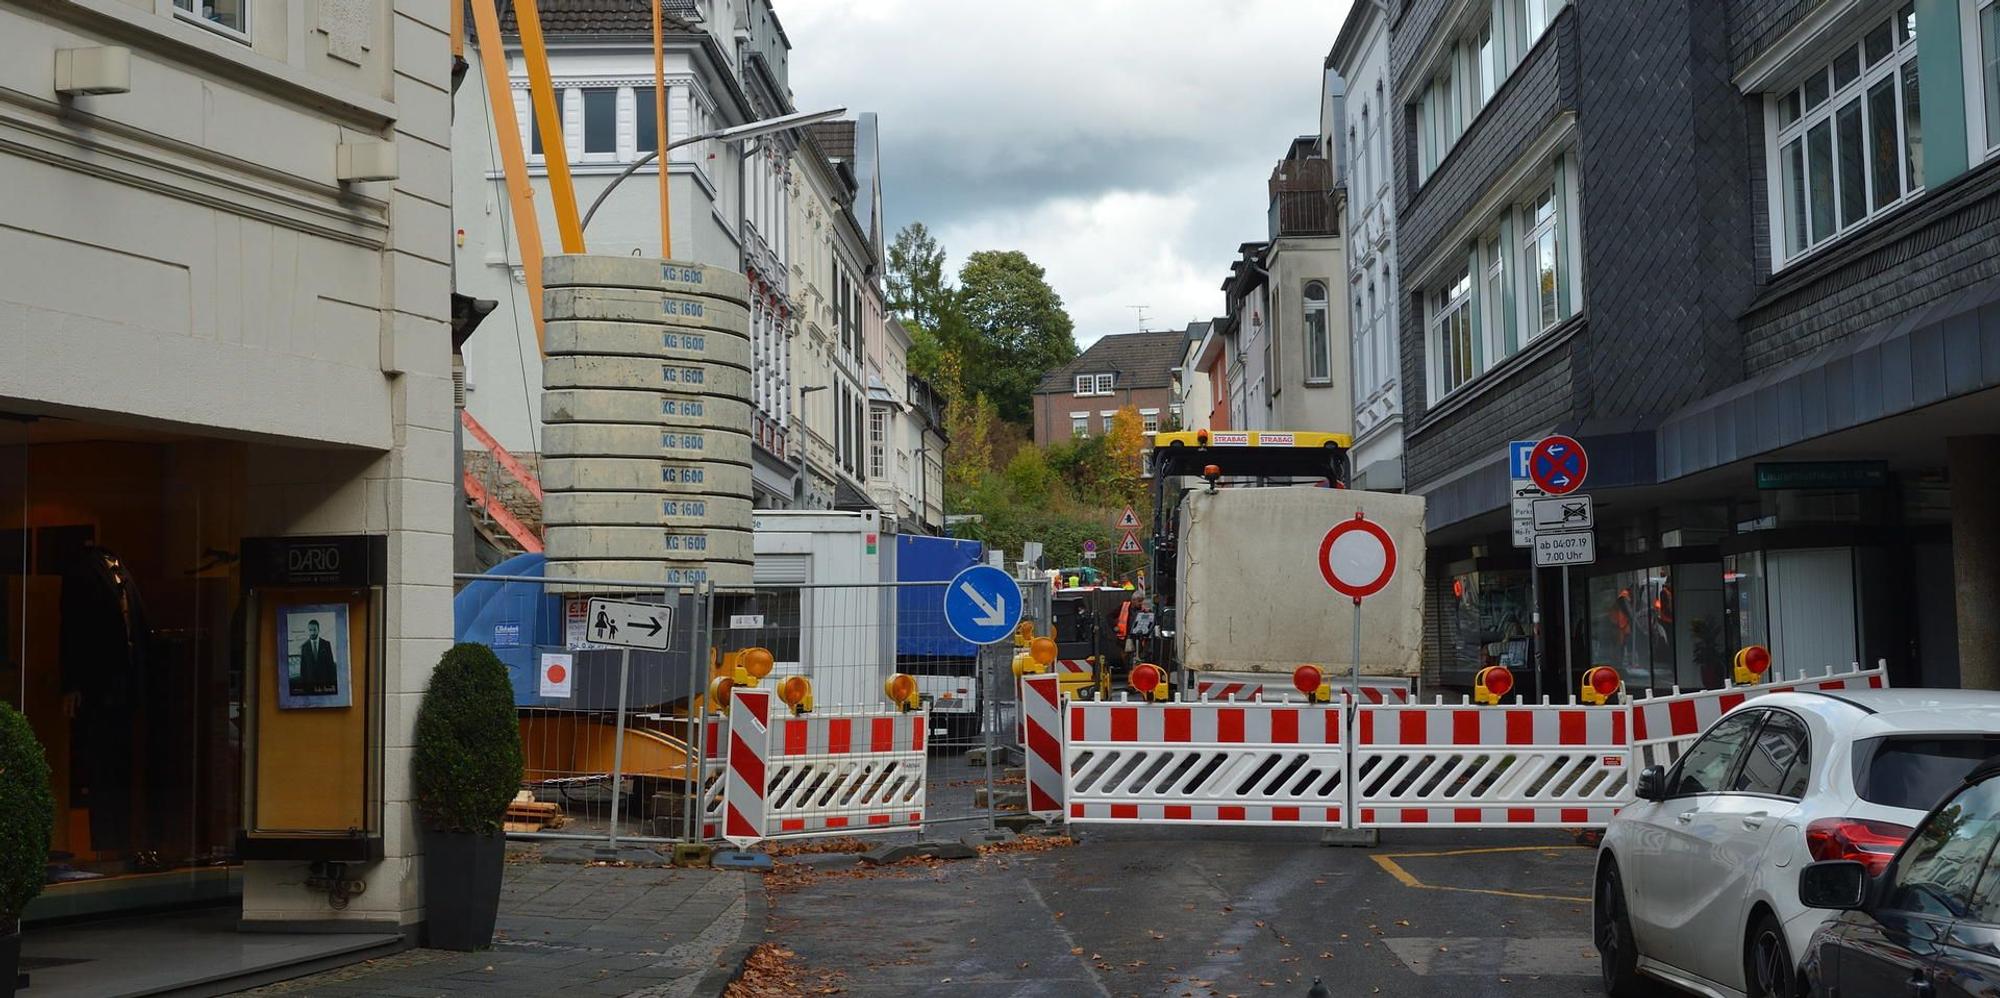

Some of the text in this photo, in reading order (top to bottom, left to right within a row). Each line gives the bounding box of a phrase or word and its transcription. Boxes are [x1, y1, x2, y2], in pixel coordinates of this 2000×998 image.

[663, 267, 702, 284] KG 1600
[664, 300, 703, 317] KG 1600
[664, 334, 704, 351] KG 1600
[663, 368, 704, 384] KG 1600
[662, 401, 703, 417] KG 1600
[662, 434, 704, 450] KG 1600
[662, 468, 704, 483] KG 1600
[664, 502, 705, 517] KG 1600
[666, 536, 706, 551] KG 1600
[1540, 537, 1587, 550] ab 04.07.19
[1566, 551, 1583, 560] Uhr
[667, 569, 706, 584] KG 1600
